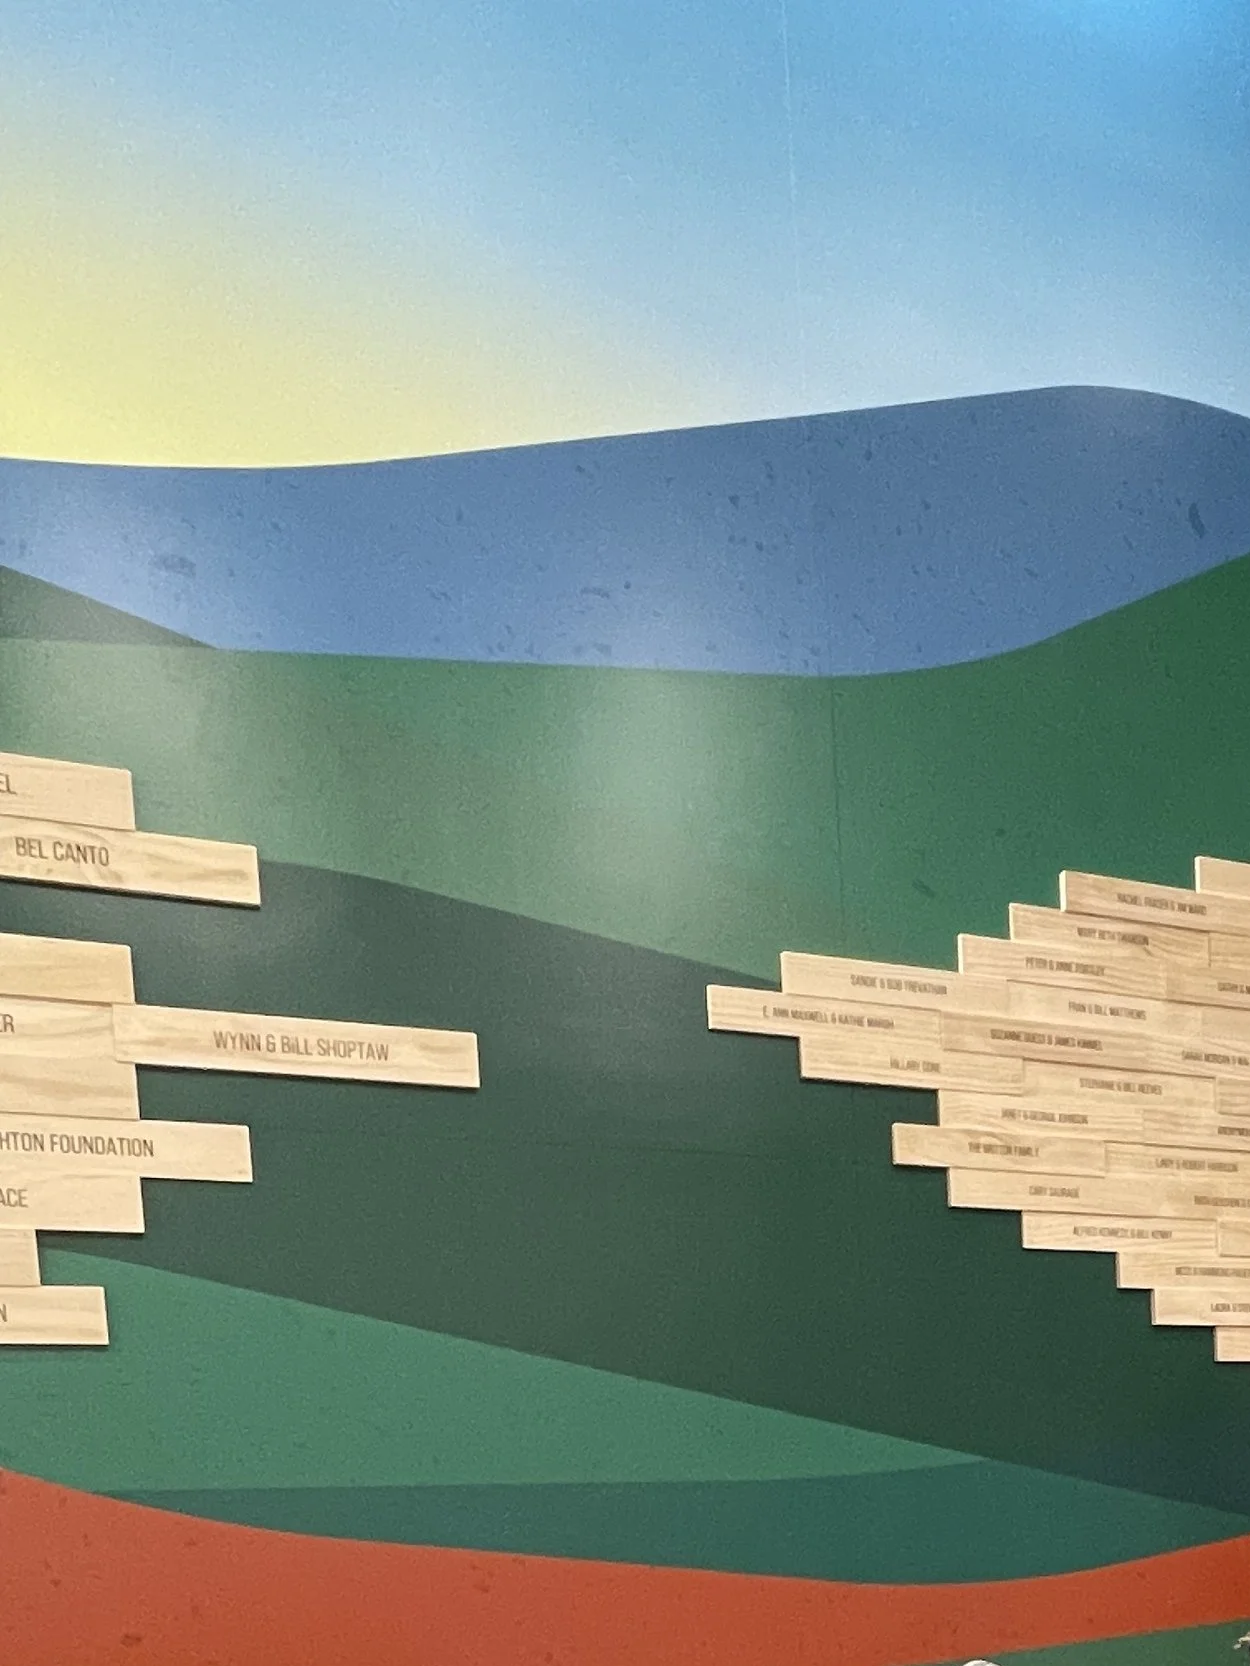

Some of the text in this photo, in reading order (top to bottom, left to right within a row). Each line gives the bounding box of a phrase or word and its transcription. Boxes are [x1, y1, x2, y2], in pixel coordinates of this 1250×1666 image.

[15, 836, 110, 867] BEL CANTO
[213, 1031, 389, 1062] WYNN & BILL SHOPTAW
[49, 1133, 155, 1158] FOUNDATION
